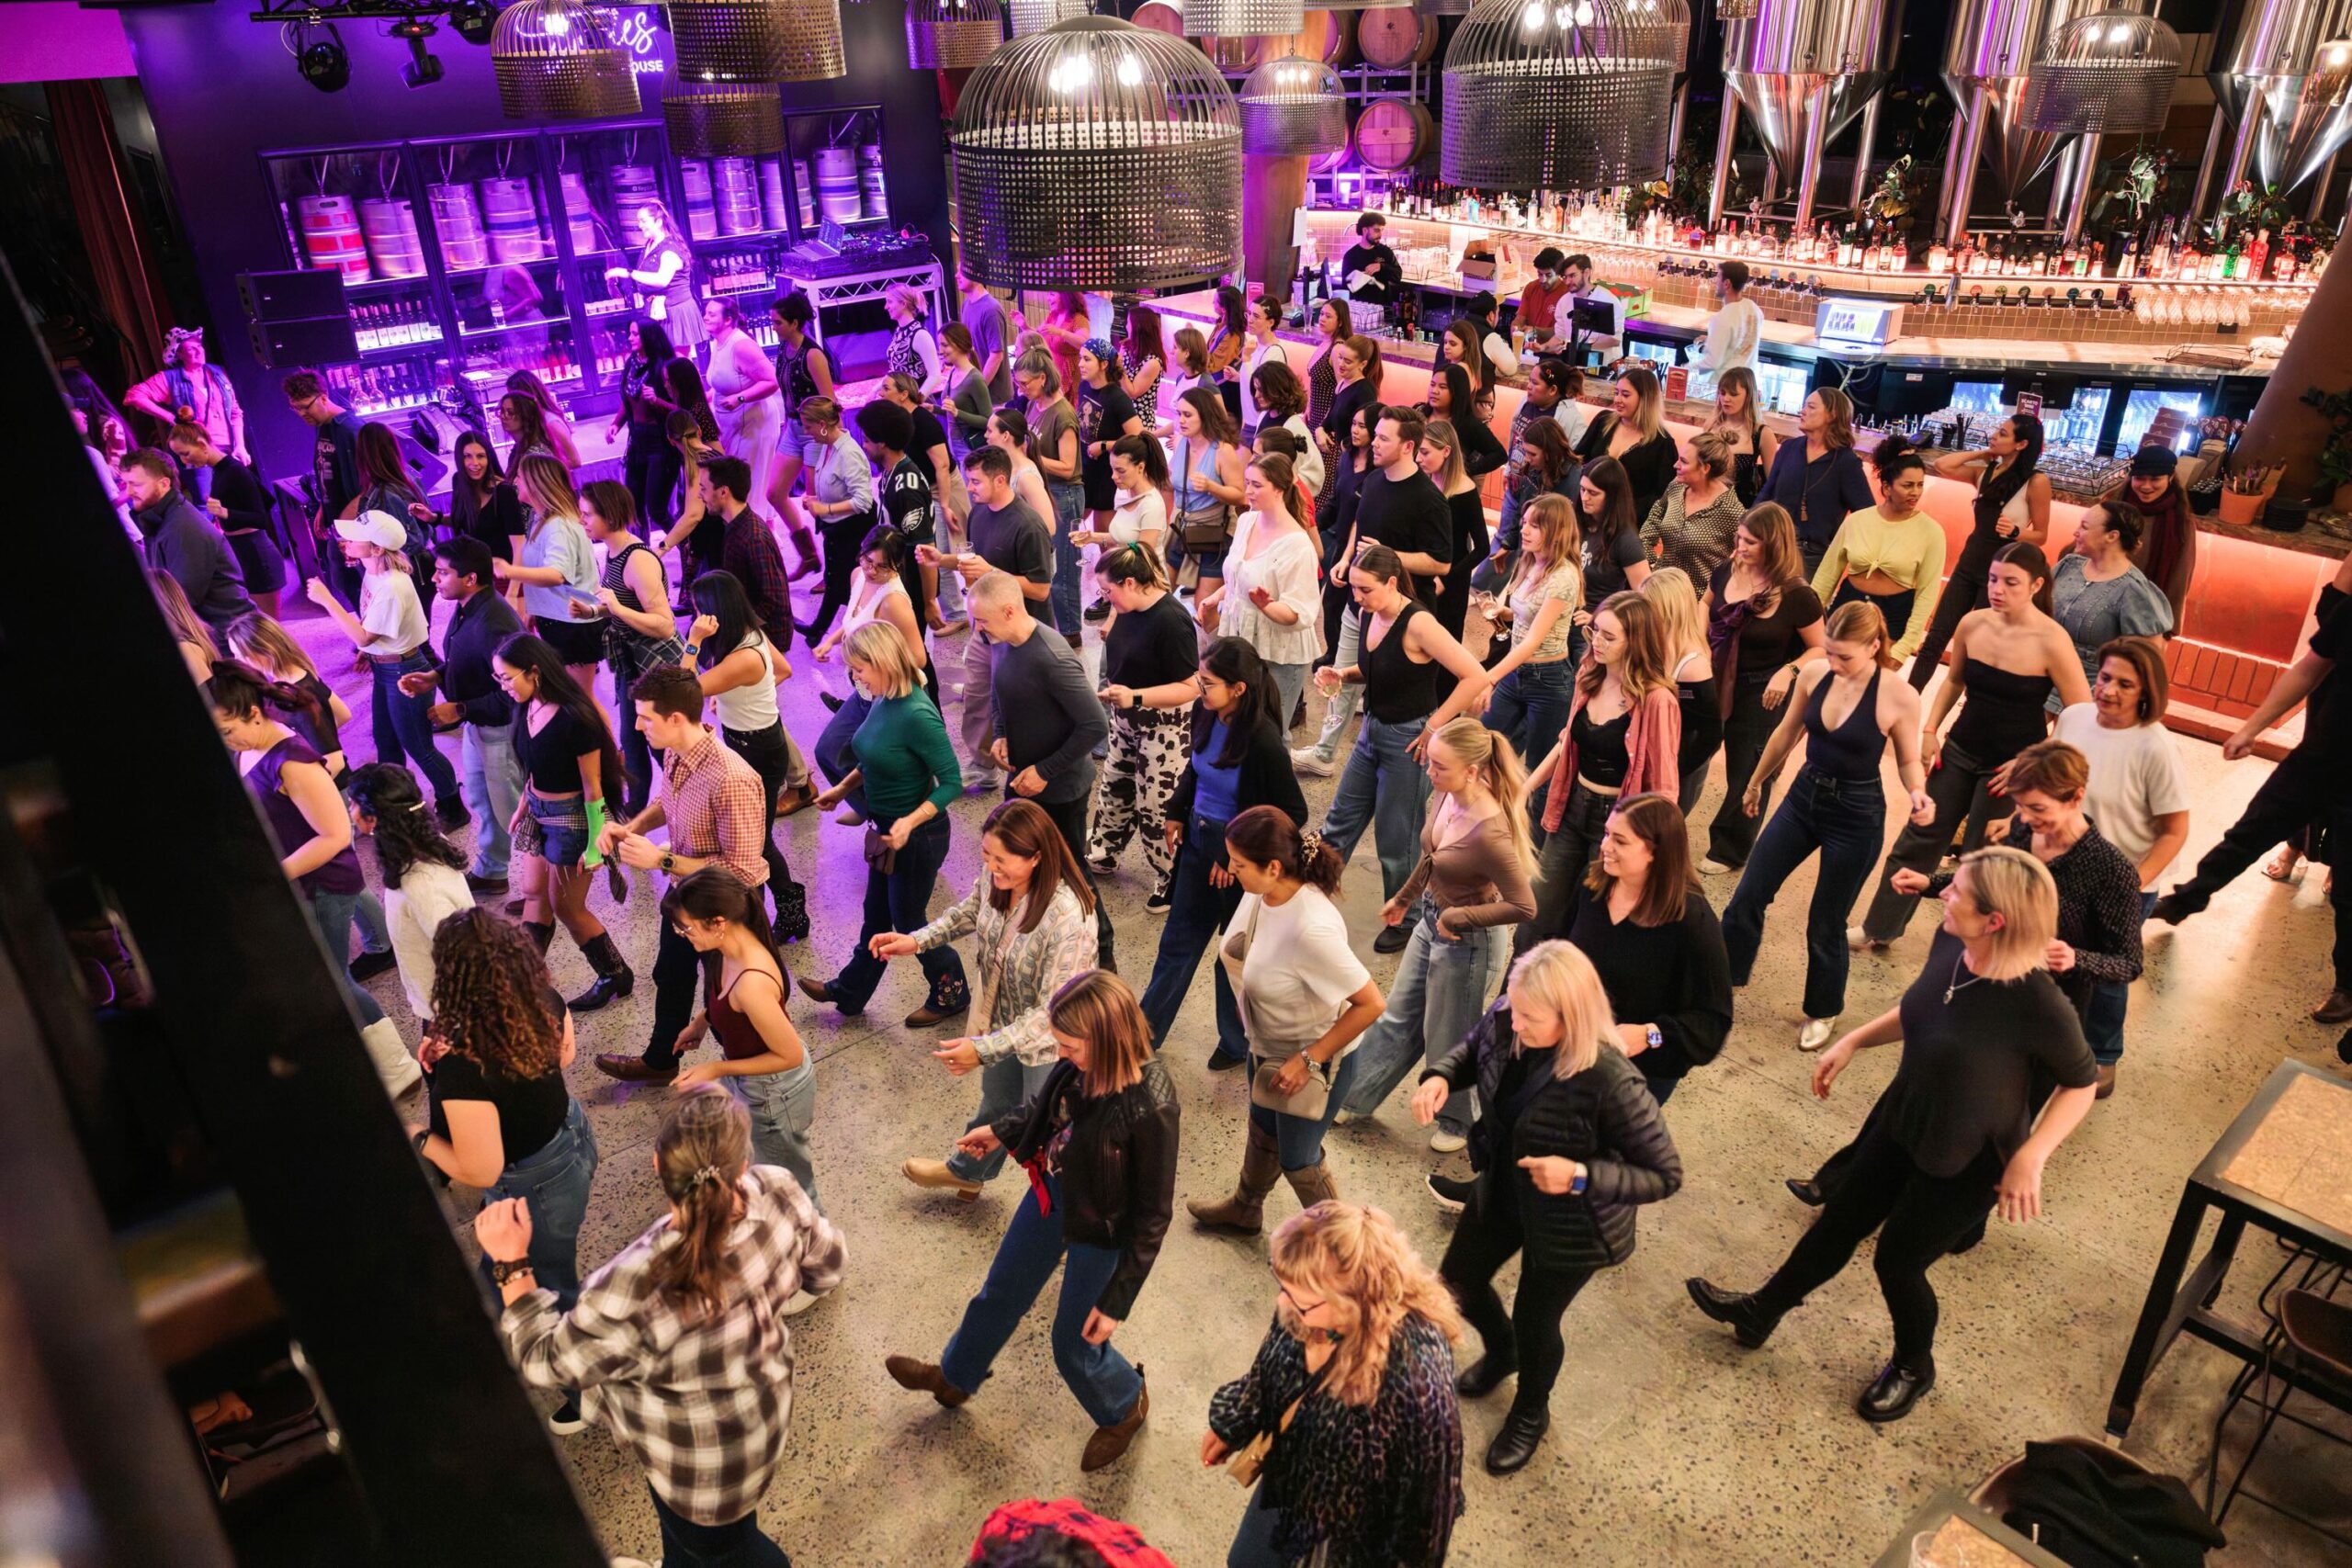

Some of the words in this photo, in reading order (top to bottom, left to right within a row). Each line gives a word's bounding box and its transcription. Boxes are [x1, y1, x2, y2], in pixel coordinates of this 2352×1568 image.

[616, 11, 658, 54] es
[630, 60, 664, 73] OUSE
[895, 471, 919, 492] 20
